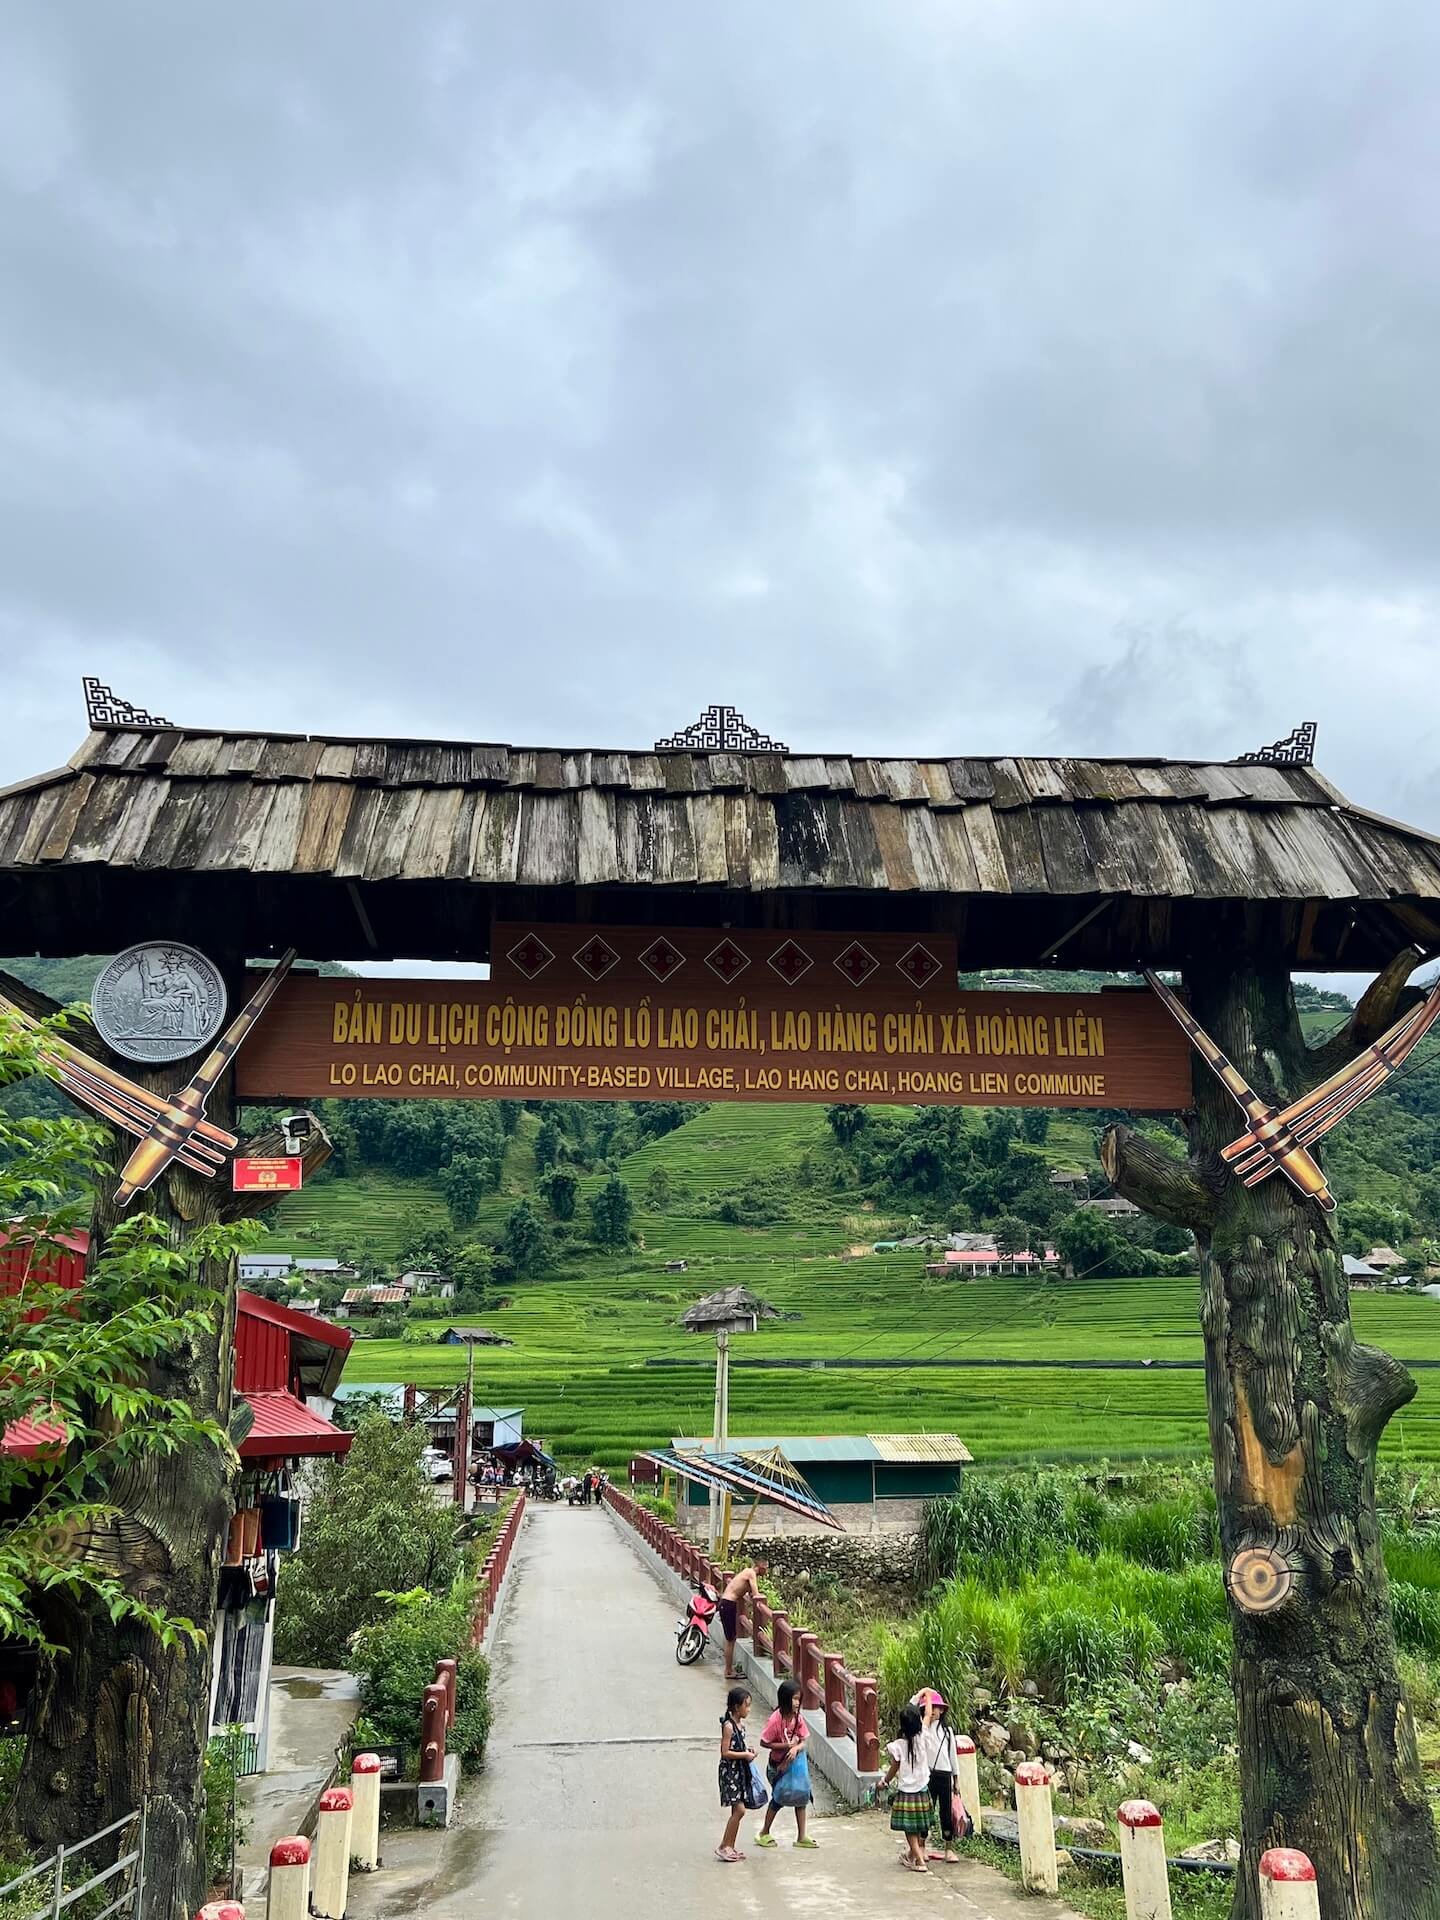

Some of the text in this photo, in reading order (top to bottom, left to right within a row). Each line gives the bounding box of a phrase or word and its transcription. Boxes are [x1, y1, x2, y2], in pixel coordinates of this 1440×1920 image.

[332, 989, 1105, 1057] BẢN DU LỊCH CỘNG ĐỒNG LỒ LAO CHẢI, LAO HÀNG CHẢI XÃ HOÀNG LIÊN
[329, 1063, 1105, 1096] LO LAO CHAI, COMMUNITY-BASED VILLAGE, LAO HANG CHAI, HOANG LIEN COMMUNE
